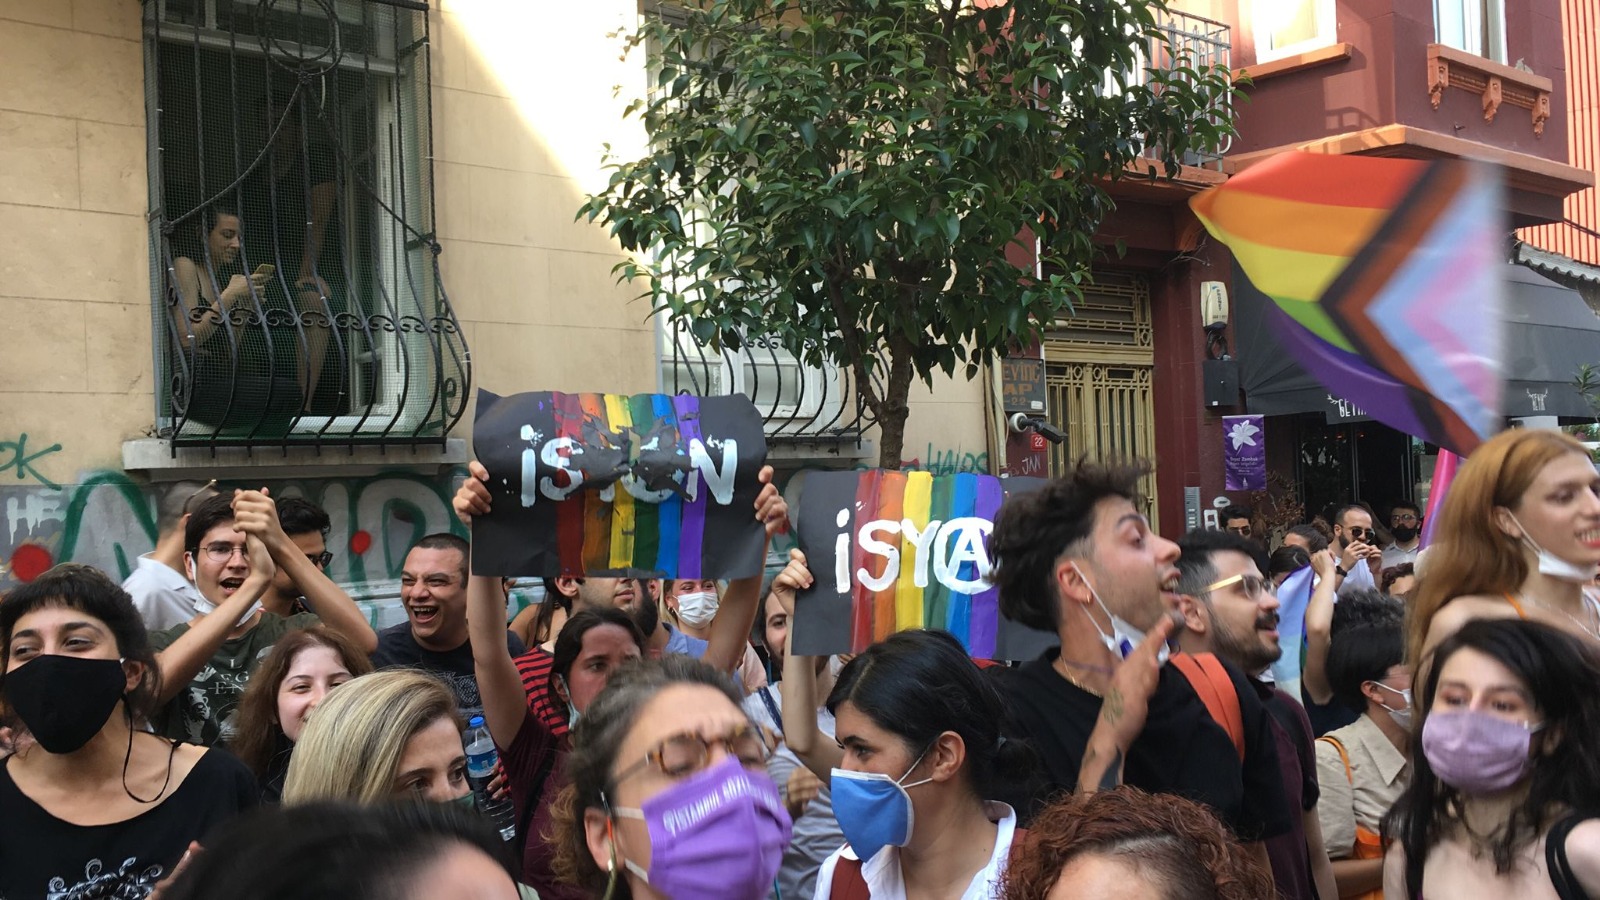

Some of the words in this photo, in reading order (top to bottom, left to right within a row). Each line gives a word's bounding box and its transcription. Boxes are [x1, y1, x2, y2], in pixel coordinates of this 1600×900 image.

[1003, 383, 1033, 395] AP
[1034, 436, 1044, 447] 22
[834, 506, 1000, 595] iSYA
[214, 681, 245, 694] EN
